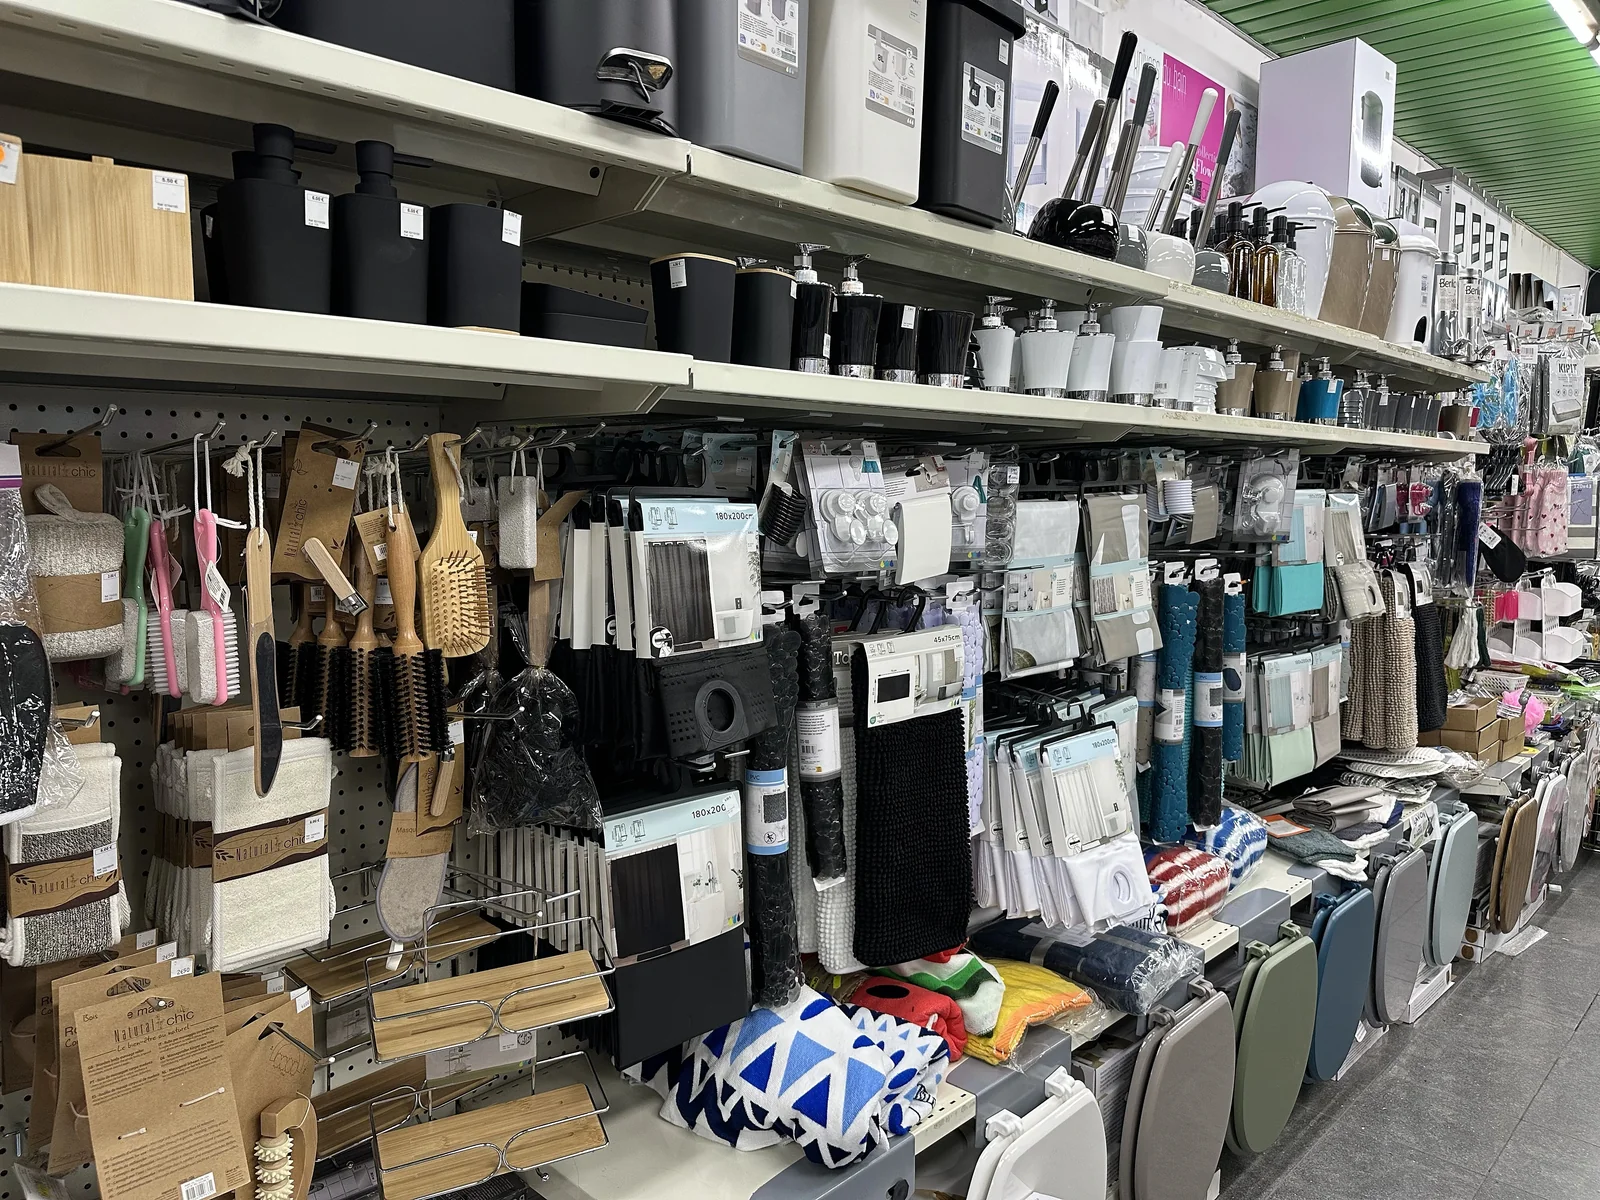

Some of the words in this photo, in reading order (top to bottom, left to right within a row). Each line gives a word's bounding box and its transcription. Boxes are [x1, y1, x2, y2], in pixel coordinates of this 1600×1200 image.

[71, 466, 96, 478] chic
[296, 499, 308, 521] chic
[715, 511, 754, 521] 180x200cm
[933, 635, 961, 643] 45x75cm
[833, 651, 852, 665] To
[236, 839, 273, 861] Natural
[32, 877, 69, 895] Natural
[114, 1019, 155, 1043] Natural
[166, 1010, 195, 1027] chic
